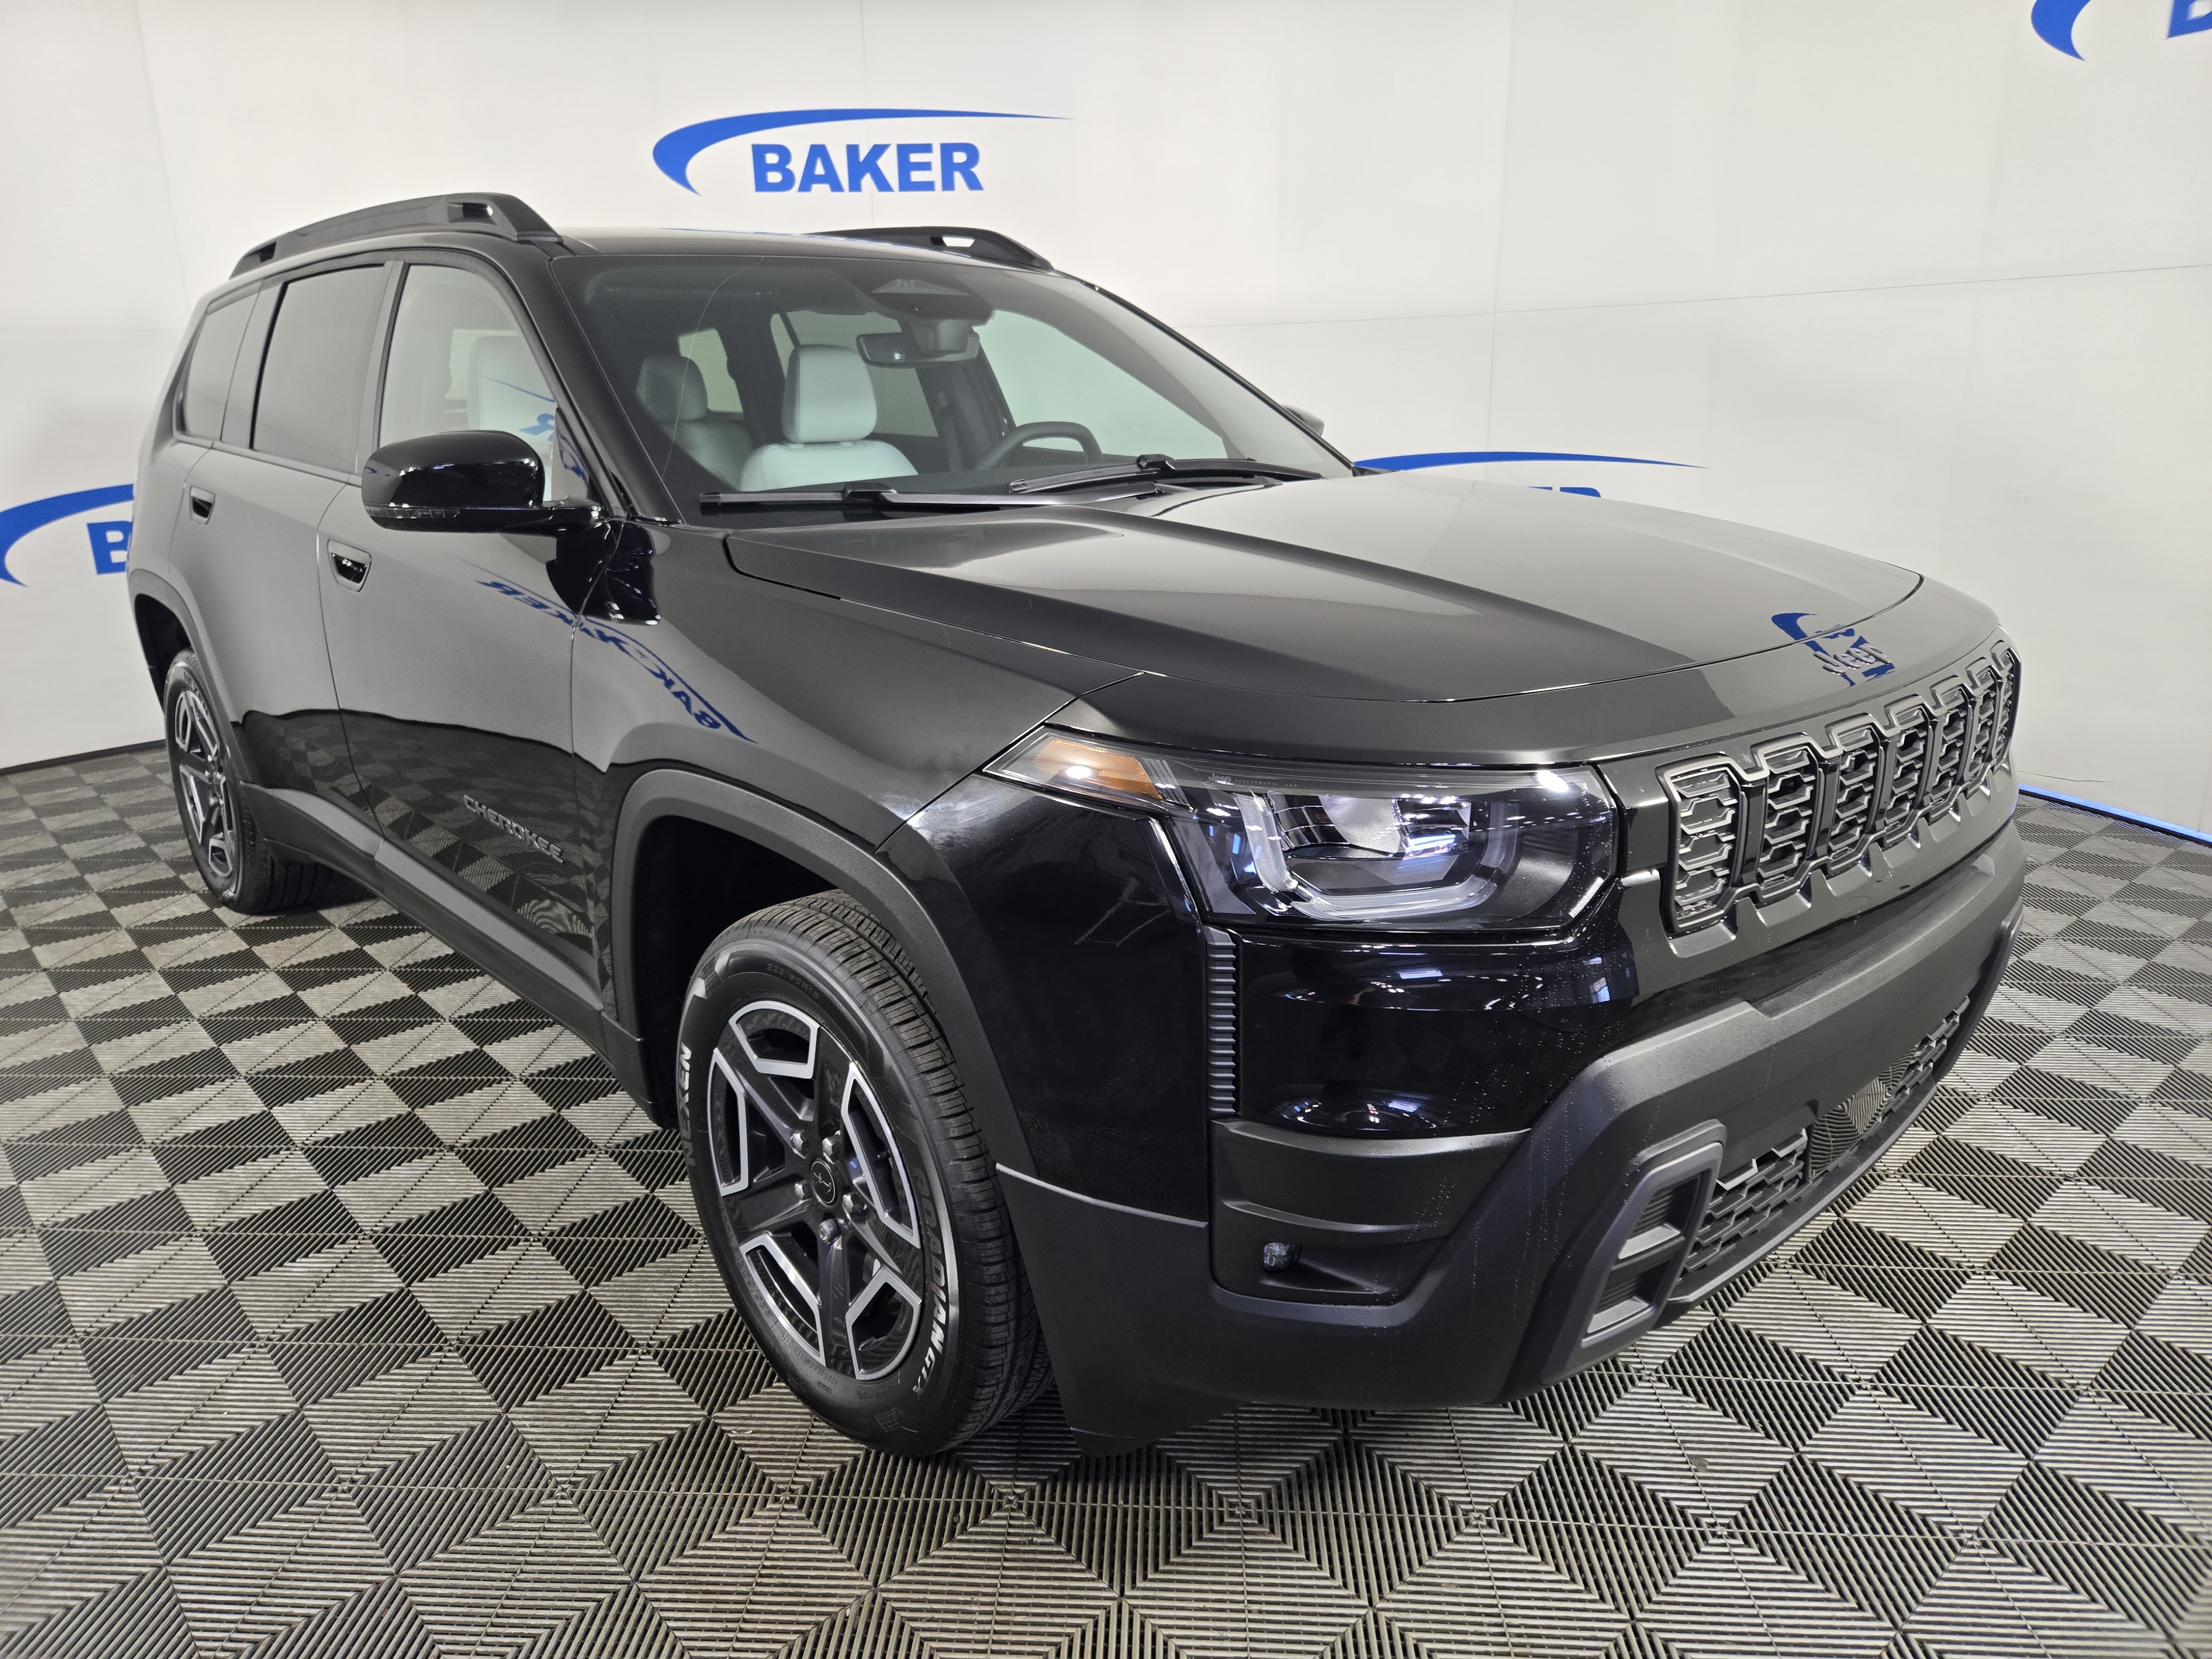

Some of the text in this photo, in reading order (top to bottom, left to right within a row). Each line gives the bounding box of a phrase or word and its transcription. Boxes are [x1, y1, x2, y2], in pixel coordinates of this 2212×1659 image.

[751, 142, 984, 192] BAKER
[1814, 644, 1892, 675] Jeep
[1208, 773, 1232, 782] Jeep
[463, 795, 564, 863] CHEROKEE
[679, 1042, 696, 1166] NEXEN
[913, 1167, 946, 1400] ROADIAN GTX
